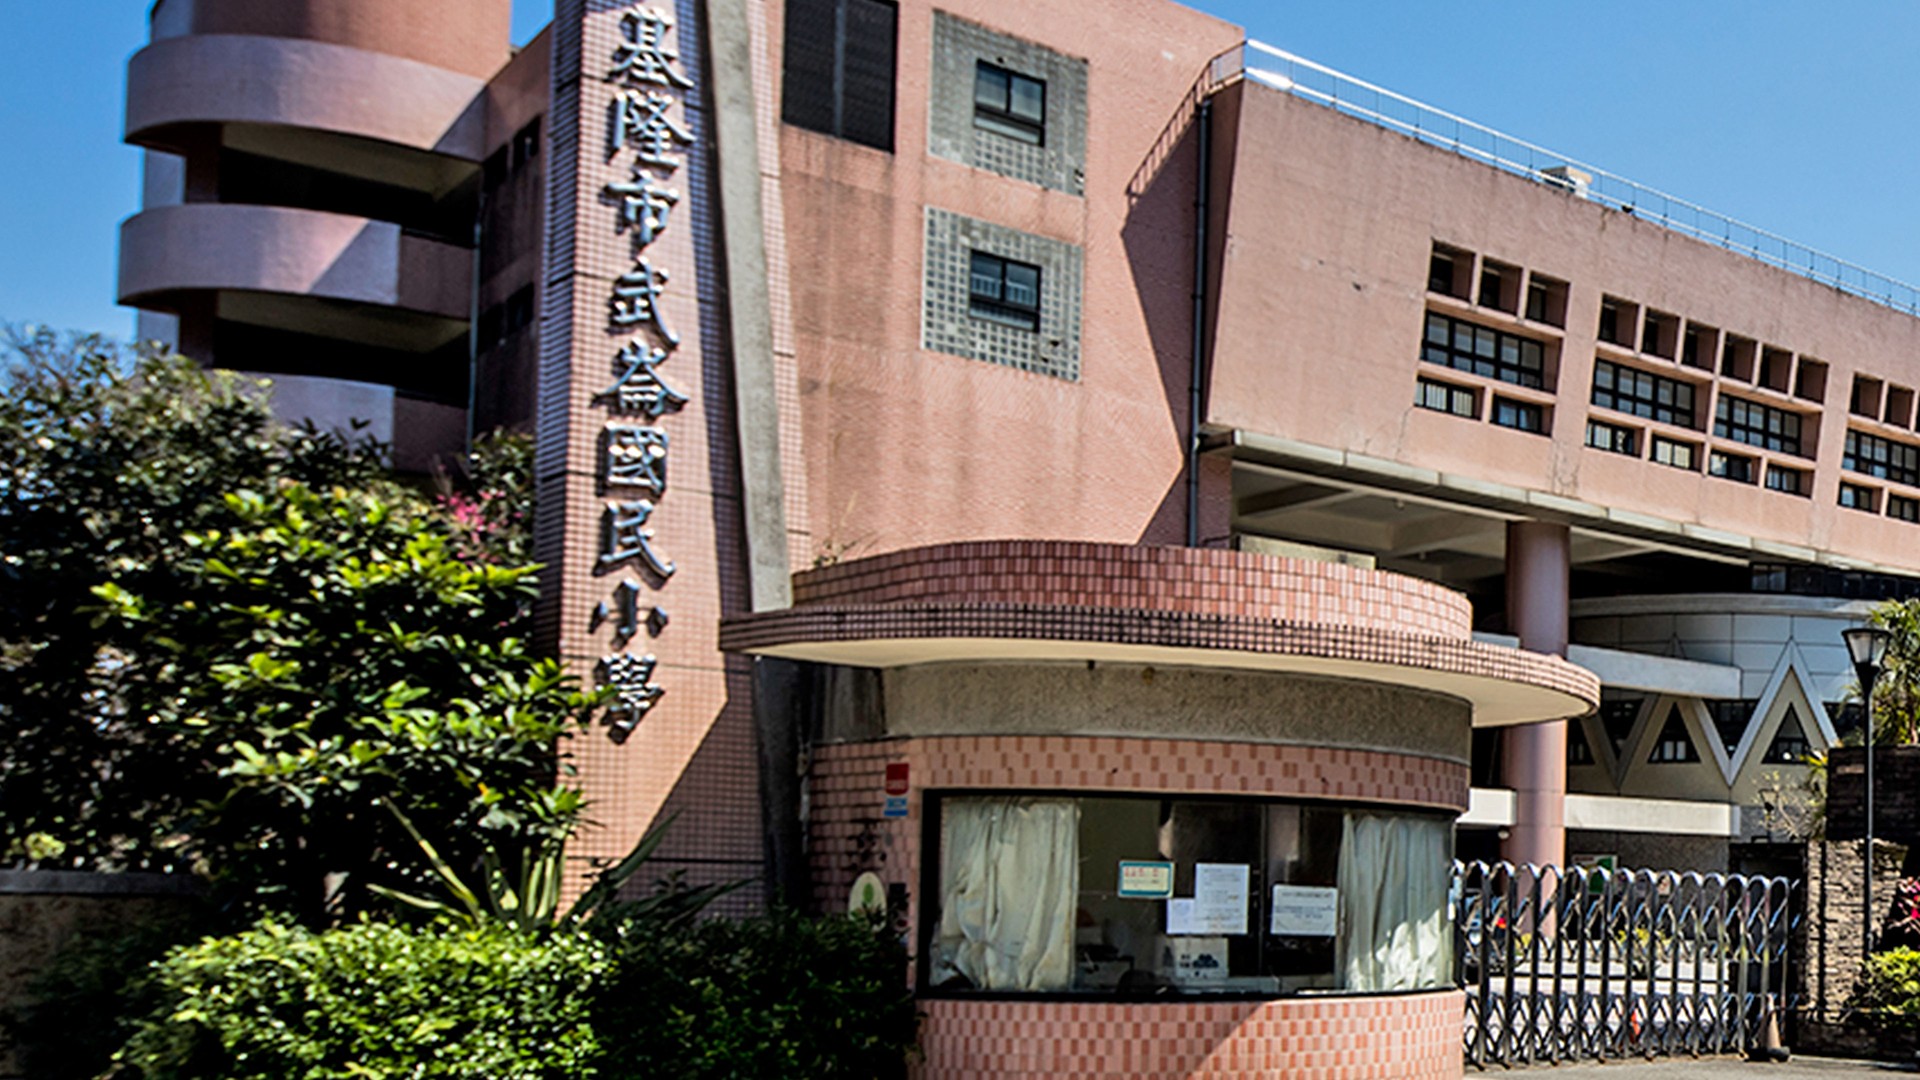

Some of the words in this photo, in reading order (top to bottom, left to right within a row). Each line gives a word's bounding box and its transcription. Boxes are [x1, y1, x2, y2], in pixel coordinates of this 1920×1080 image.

[593, 5, 697, 740] 基隆市武崙國民小學
